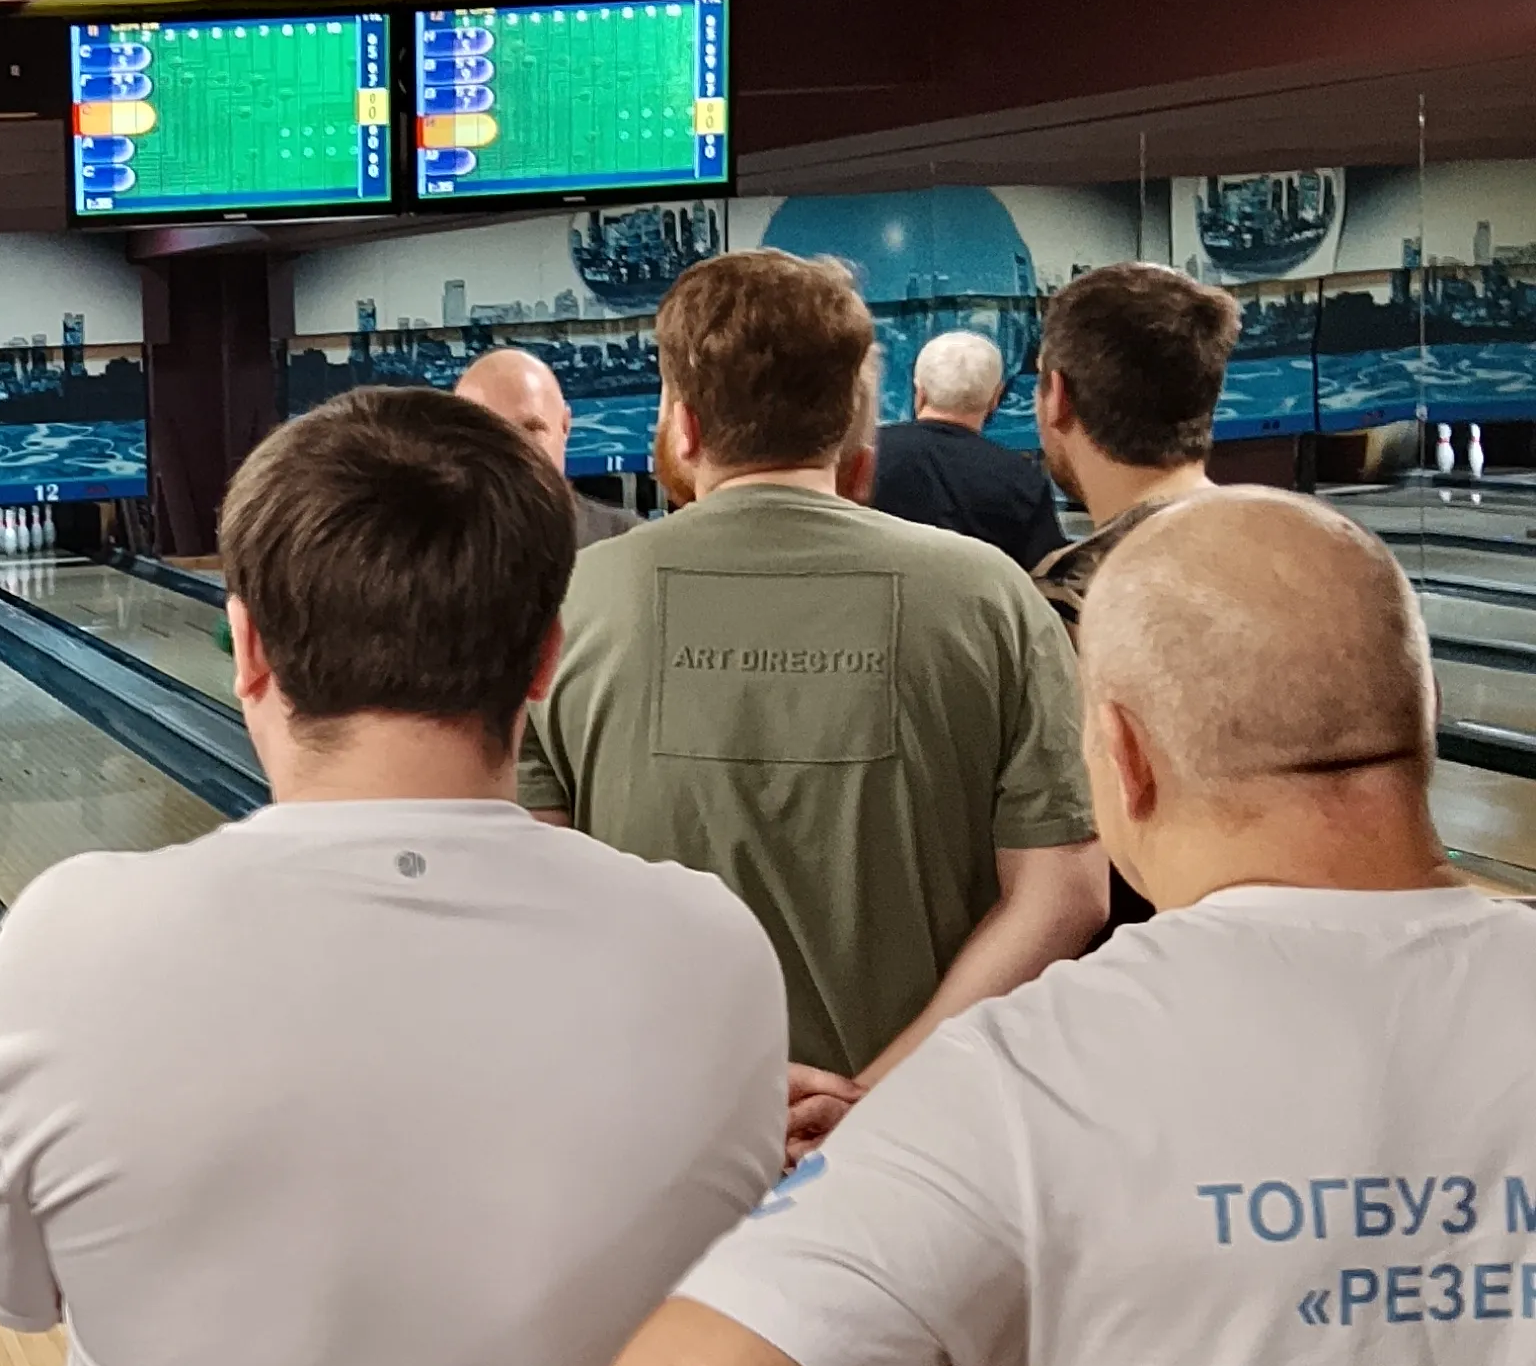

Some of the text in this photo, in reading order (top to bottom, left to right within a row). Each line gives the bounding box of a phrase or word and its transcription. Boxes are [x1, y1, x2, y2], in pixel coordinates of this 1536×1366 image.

[34, 484, 60, 502] 12
[673, 646, 885, 674] ART DIRECTOR
[1196, 1175, 1478, 1245] ТОГБУЗ
